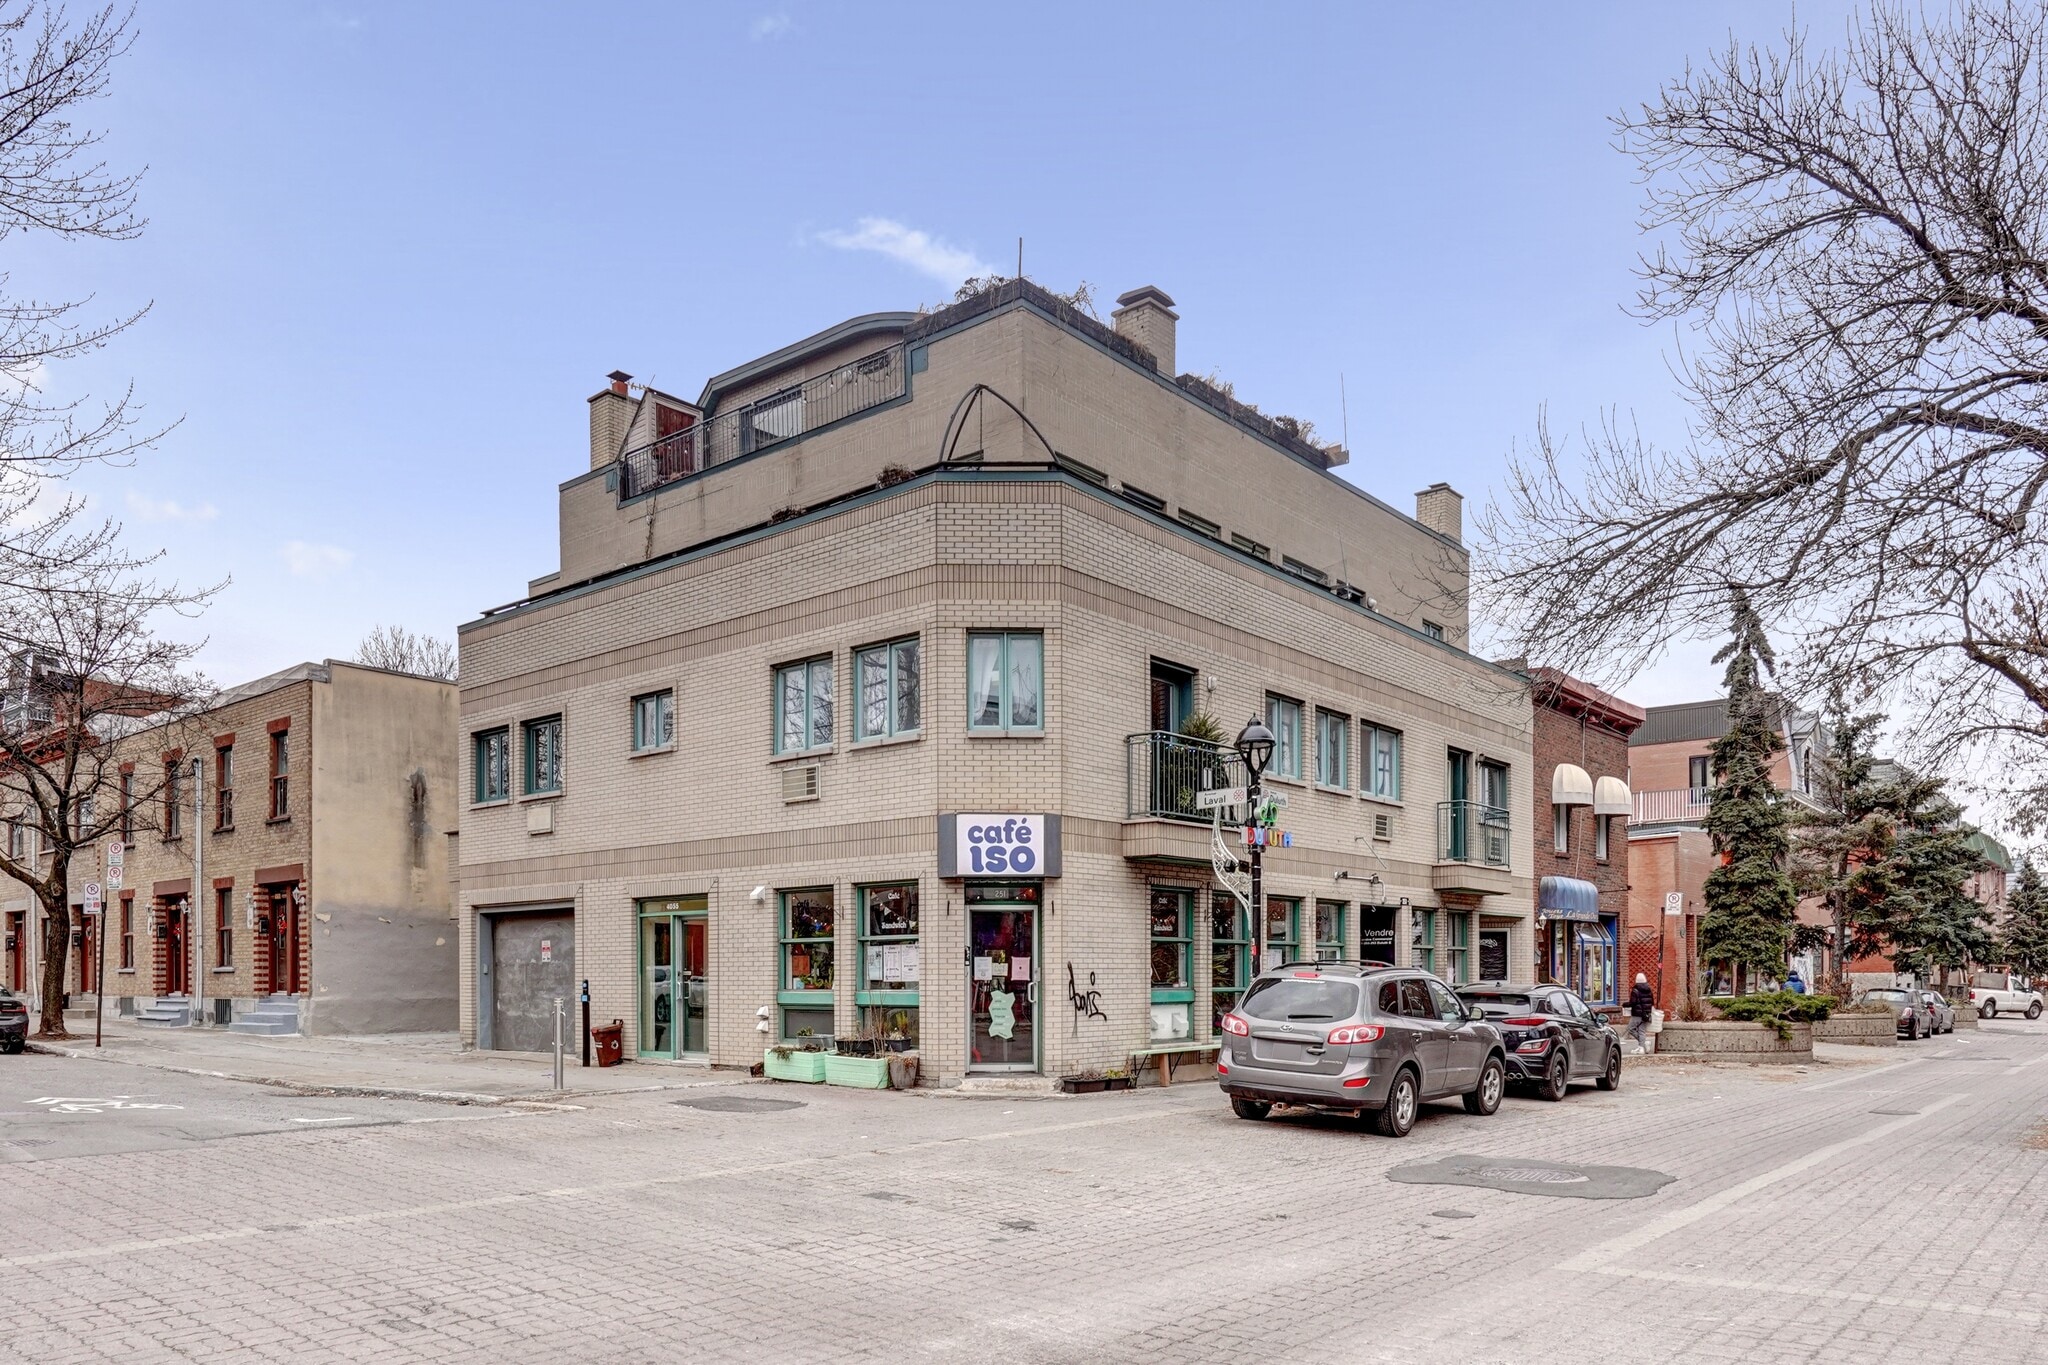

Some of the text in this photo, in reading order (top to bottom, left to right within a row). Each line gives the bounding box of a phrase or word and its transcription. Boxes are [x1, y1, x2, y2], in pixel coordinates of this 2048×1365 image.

[1205, 795, 1226, 805] Laval
[1270, 795, 1287, 806] Duluth
[968, 817, 1032, 844] café
[1247, 827, 1292, 847] DULUTH
[995, 890, 1006, 898] 251
[882, 921, 907, 929] Sandwich
